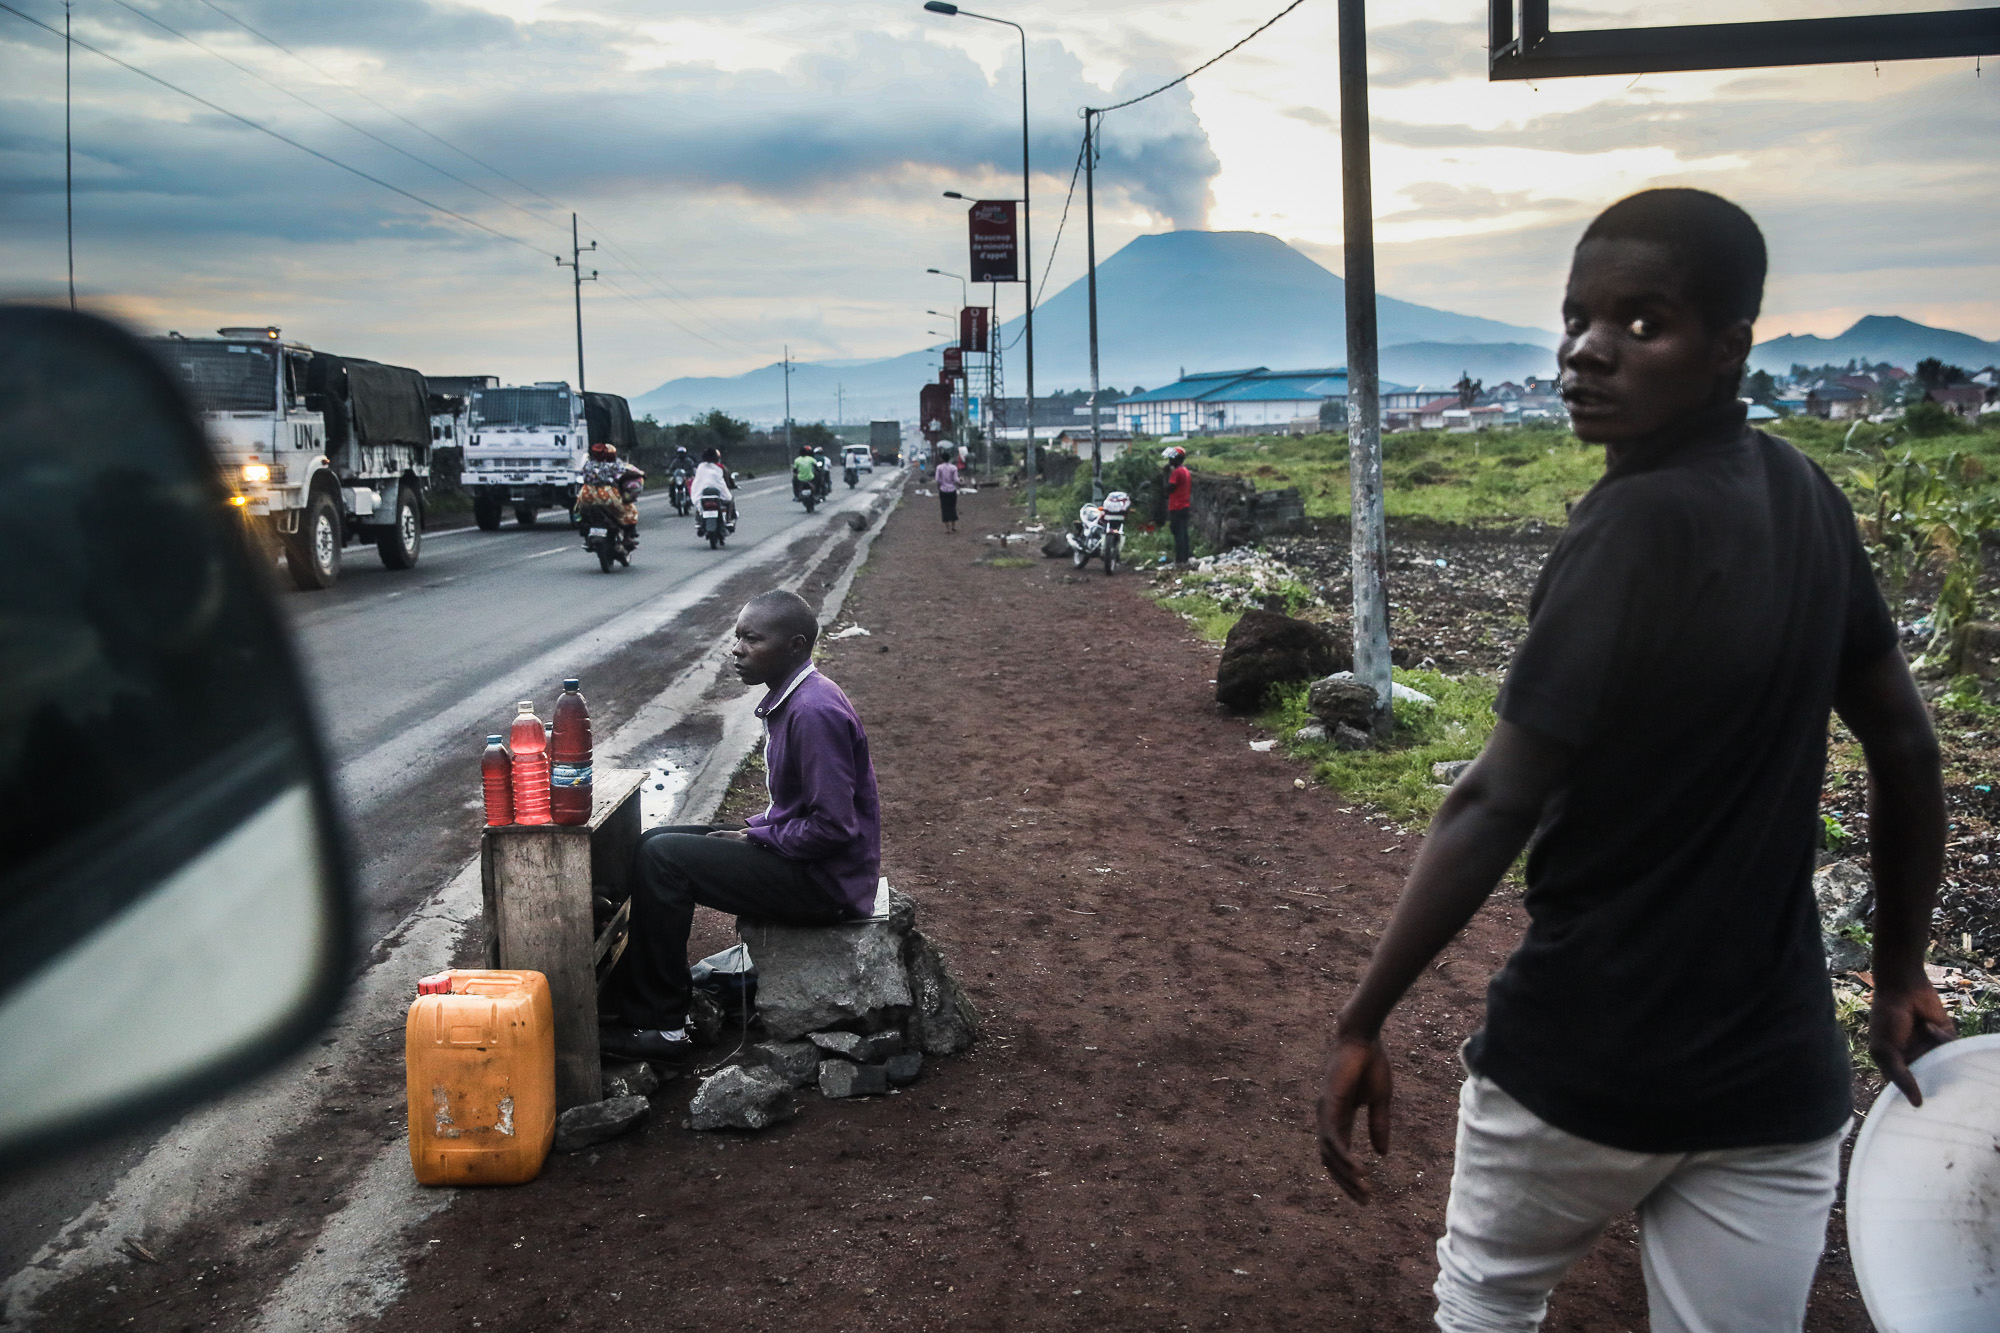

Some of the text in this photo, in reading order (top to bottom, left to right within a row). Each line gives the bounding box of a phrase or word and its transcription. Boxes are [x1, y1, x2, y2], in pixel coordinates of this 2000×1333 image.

[974, 234, 1011, 242] Beaucoup
[972, 243, 982, 251] de
[979, 251, 1008, 260] d'appel
[294, 422, 313, 450] UN
[469, 434, 567, 446] U N
